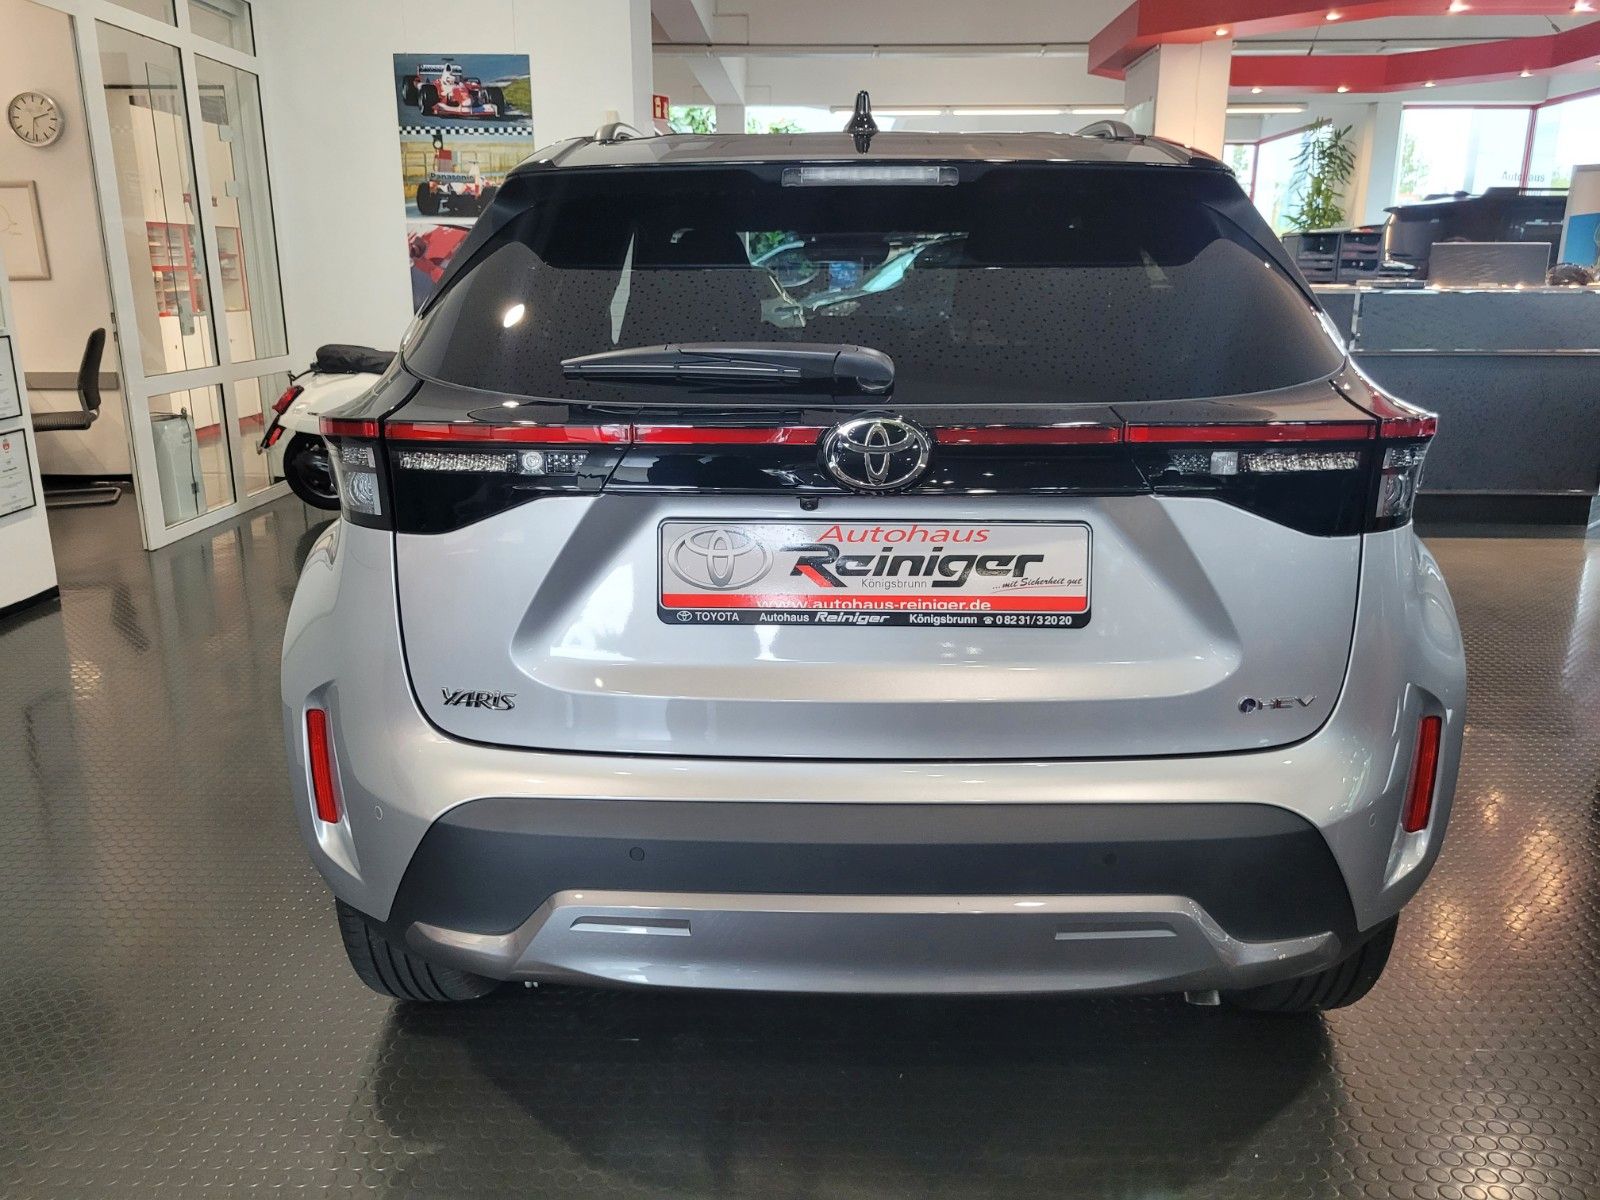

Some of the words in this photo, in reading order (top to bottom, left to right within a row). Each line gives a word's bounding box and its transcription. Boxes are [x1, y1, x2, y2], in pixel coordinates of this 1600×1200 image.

[1502, 171, 1545, 182] Autoaus
[816, 524, 991, 543] Autohaus
[780, 543, 1044, 588] Reiniger
[861, 578, 927, 590] Königsbrunn
[1020, 577, 1065, 586] Sicherheit
[1066, 578, 1082, 587] gut
[756, 598, 991, 610] www.autohaus-reiniger.de
[695, 612, 739, 622] TOYOTA
[759, 612, 809, 622] Autohaus
[814, 611, 890, 625] Reiniger
[909, 613, 977, 625] Königsbrunn
